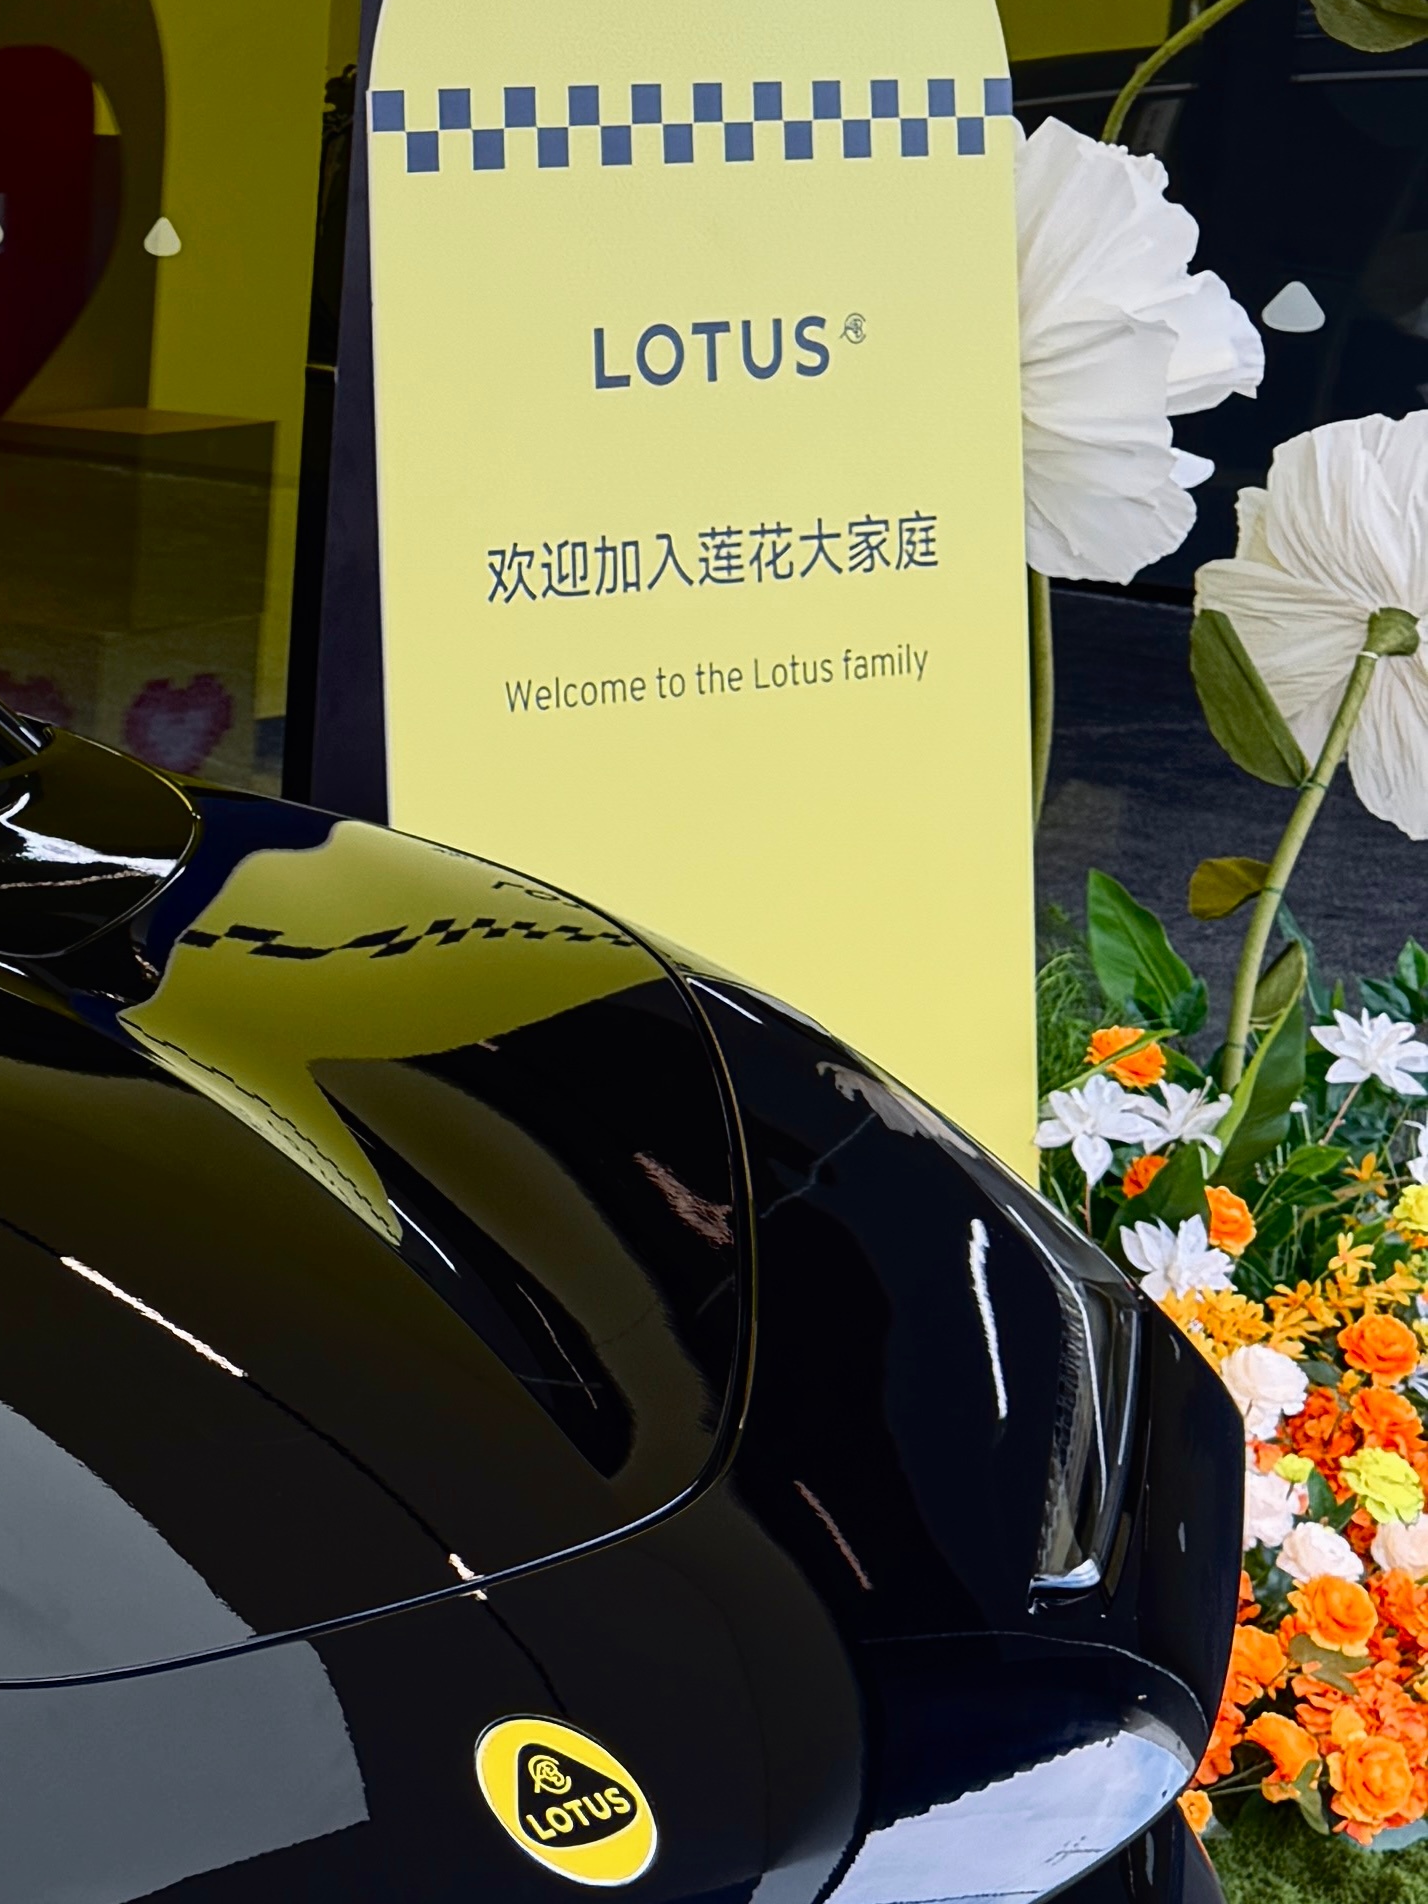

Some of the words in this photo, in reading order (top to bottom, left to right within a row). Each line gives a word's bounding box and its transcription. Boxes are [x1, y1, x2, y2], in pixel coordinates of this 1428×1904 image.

[593, 315, 830, 390] LOTUS
[485, 509, 940, 605] 欢迎加入莲花大家庭
[505, 675, 647, 714] Welcome
[655, 667, 686, 700] to
[695, 661, 744, 696] the
[753, 653, 834, 691] Lotus
[842, 643, 929, 682] family
[525, 1787, 631, 1841] LOTUS
